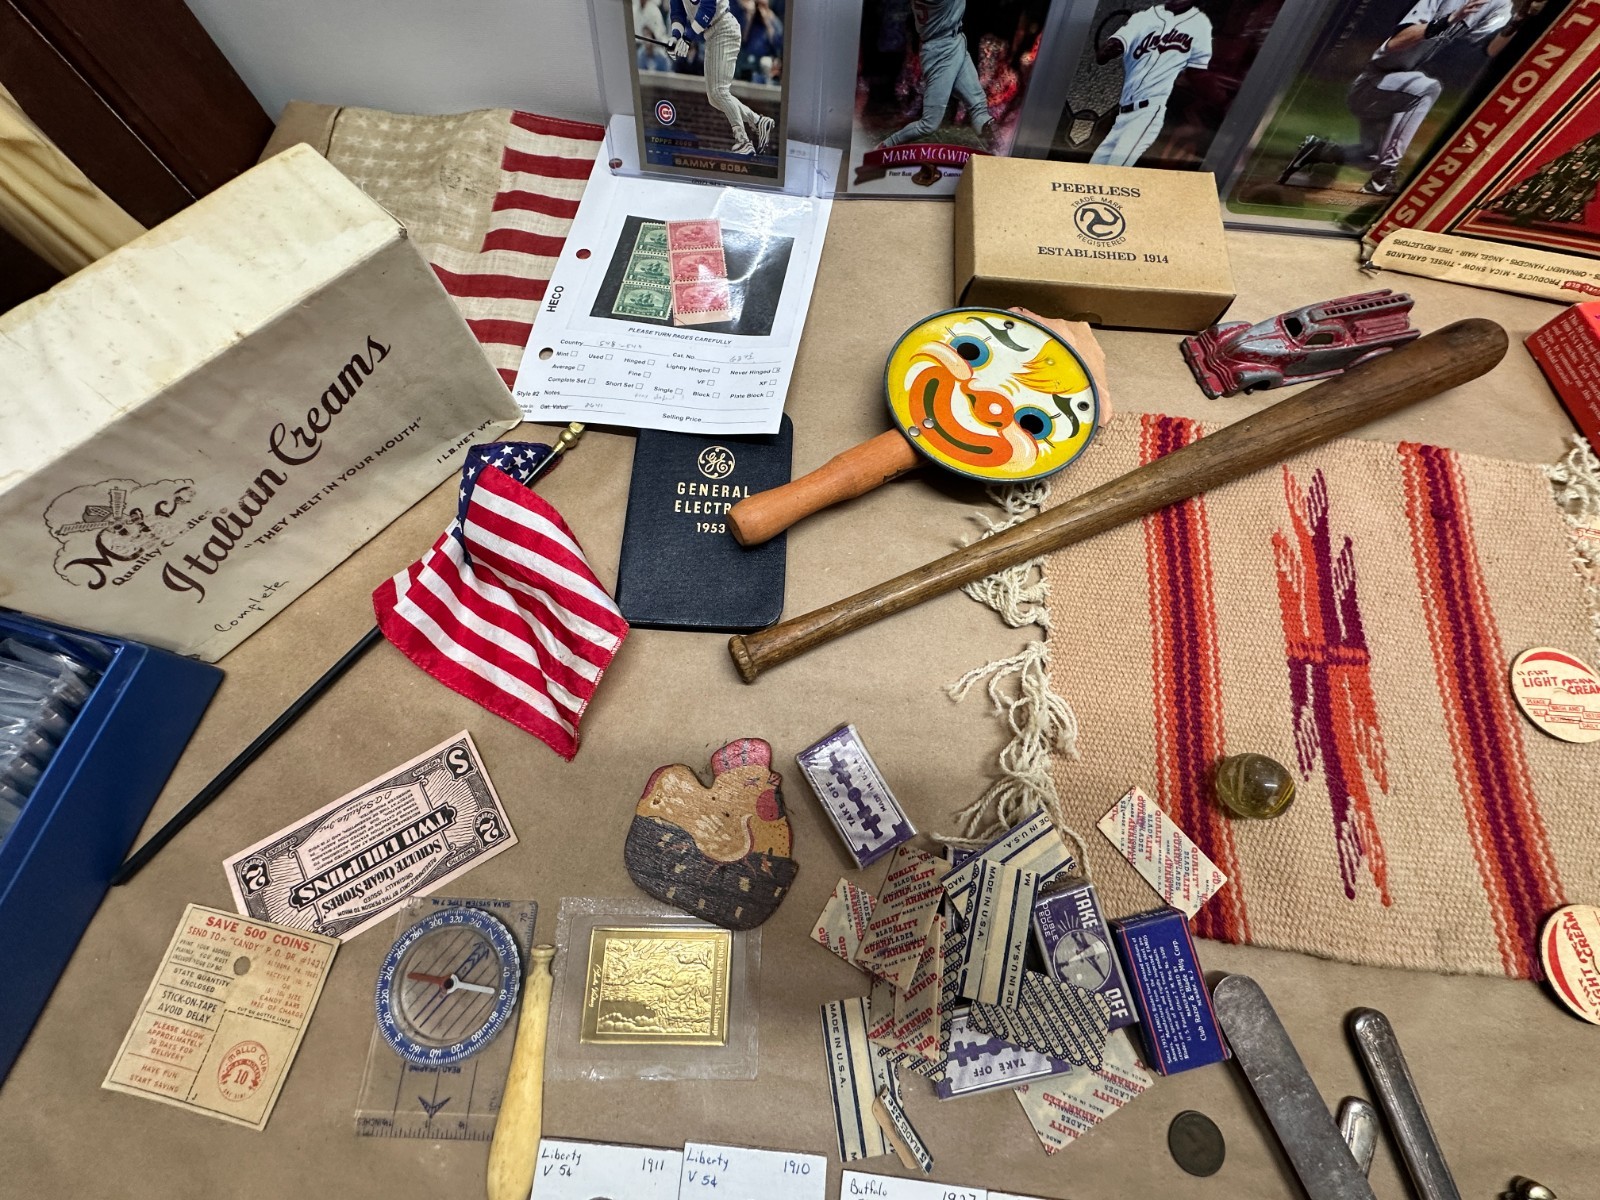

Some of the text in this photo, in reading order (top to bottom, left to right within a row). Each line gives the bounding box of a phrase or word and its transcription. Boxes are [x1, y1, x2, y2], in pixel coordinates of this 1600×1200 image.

[1133, 30, 1193, 60] Indians
[1375, 43, 1567, 238] NOT TARNISH
[883, 147, 969, 163] MARK McGWIR
[1052, 181, 1141, 198] PEERLESS
[1071, 196, 1123, 211] TRADE MARK
[1077, 234, 1126, 248] REGISTERED
[1037, 246, 1169, 263] ESTABLISHED 1914
[1391, 238, 1587, 278] ORNAMENT HANGERS ANGEL HAIR TREE REFLECTORS
[1385, 249, 1560, 286] PRODUCTS MICA SNOW TINSEL GARLANDS
[546, 285, 564, 313] HECO
[628, 327, 732, 345] PLEASE TURN PAGES CAREFULLY
[556, 350, 569, 358] Mint
[624, 357, 646, 366] Hinged
[628, 370, 642, 378] Fine
[685, 415, 702, 423] Price
[457, 431, 477, 450] NET
[477, 419, 495, 434] WT.
[161, 335, 391, 603] Italian Creams
[677, 482, 751, 498] GENERAL
[244, 514, 292, 550] "THEY
[289, 491, 324, 520] MELT
[323, 479, 339, 497] IN
[337, 454, 374, 483] YOUR
[675, 500, 732, 515] ELECTR
[696, 522, 726, 533] 1953
[112, 547, 163, 586] Quality
[214, 579, 289, 633] Complete
[1522, 677, 1557, 687] LIGHT
[825, 779, 857, 827] TAKE OFF
[865, 782, 887, 812] MADE IN
[397, 808, 449, 847] TWO
[482, 817, 499, 842] 2
[1003, 823, 1038, 849] IN U.S.A.
[244, 865, 265, 891] 2
[296, 835, 400, 904] COUPONS
[318, 838, 443, 919] SCHULTE CIGAR STORES'
[361, 870, 413, 904] ORIGINALLY ISSUED
[977, 866, 995, 940] MADE IN U.S.A.
[450, 915, 463, 925] 320
[1038, 910, 1050, 937] EDGE
[1042, 902, 1058, 941] DOUBLE
[186, 925, 221, 941] SEND TO
[204, 915, 317, 953] SAVE 500 COINS!
[487, 927, 498, 940] N
[498, 944, 507, 957] 20
[1013, 941, 1023, 971] U.S.A.
[1072, 888, 1128, 1019] TAKE OFF
[1169, 938, 1181, 956] Corp.
[172, 967, 230, 987] STATE QUANTITY
[384, 966, 394, 981] 240
[1010, 976, 1017, 986] IN
[1181, 973, 1191, 992] Blade
[178, 978, 216, 993] ENCLOSED
[500, 989, 508, 1000] 60
[903, 972, 937, 1002] QUALITY
[160, 989, 218, 1013] STICK-ON-TAPE
[1064, 988, 1094, 1034] DURABILITY
[156, 1001, 211, 1024] AVOID DELAY
[383, 1011, 394, 1024] 200
[488, 1011, 499, 1024] 80
[1047, 982, 1094, 1059] FINE QUALITY
[1190, 1003, 1201, 1022] Razor
[146, 1027, 203, 1049] APPROXIMATELY
[152, 1020, 205, 1040] PLEASE ALLOW
[1051, 1014, 1078, 1054] CHROME
[1196, 1025, 1207, 1041] Club
[149, 1046, 185, 1062] DELIVERY
[451, 1044, 464, 1054] 120
[829, 1003, 845, 1088] MADE IN U.S.A.
[140, 1063, 178, 1079] HAVE FUN
[232, 1068, 250, 1086] 10
[974, 1058, 1026, 1077] TAKE OFF
[128, 1073, 152, 1086] START
[898, 1120, 922, 1154] BLADES
[541, 1148, 664, 1173] Liberty 1911
[543, 1164, 553, 1176] V
[686, 1149, 811, 1175] Liberty 1910
[688, 1171, 697, 1183] V
[850, 1178, 888, 1197] Buffalo
